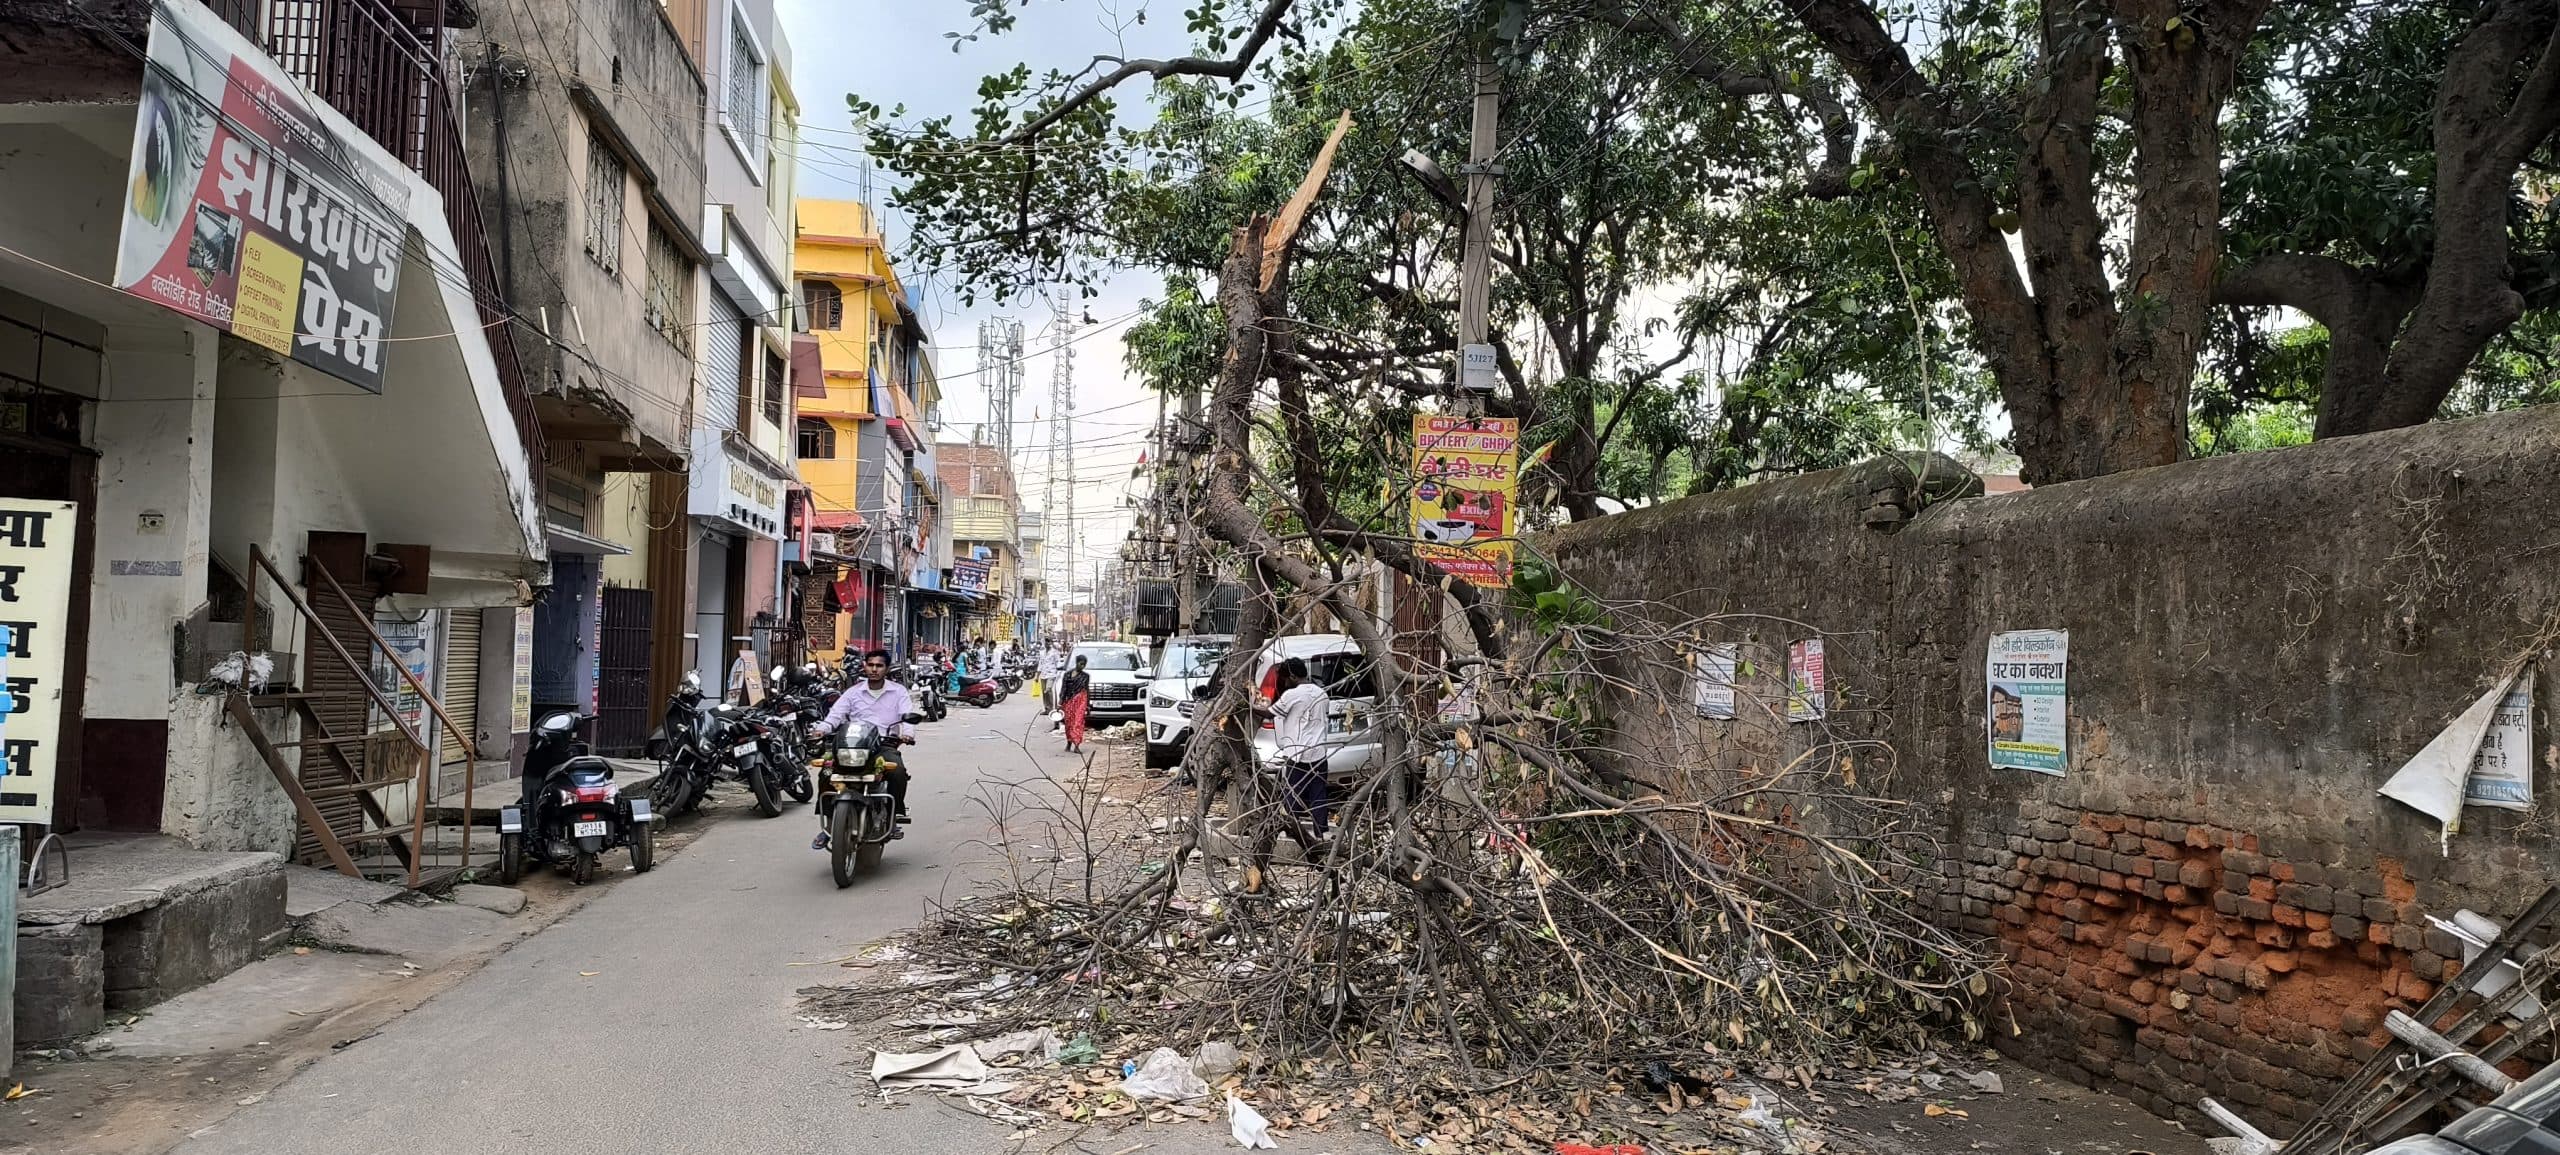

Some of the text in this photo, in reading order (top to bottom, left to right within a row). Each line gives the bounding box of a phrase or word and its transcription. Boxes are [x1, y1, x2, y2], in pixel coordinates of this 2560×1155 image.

[217, 135, 404, 294] झारखण्ड
[248, 247, 261, 263] FLEX
[246, 265, 287, 294] SCREEN PRINTING
[203, 288, 234, 325] गिरिडीह
[243, 285, 283, 312] OFFSET PRINTING
[240, 304, 281, 330] DIGITAL PRINTING
[297, 260, 384, 375] प्रेस
[253, 327, 273, 347] COLOUR
[271, 334, 290, 352] POSTER
[1419, 433, 1468, 449] BATTERY
[1473, 464, 1509, 481] घर
[1459, 504, 1491, 516] EXIDE
[2011, 637, 2022, 653] हरि
[1992, 662, 2064, 679] घर का नक्शा
[2496, 732, 2503, 751] है
[2488, 754, 2498, 769] पर
[2500, 753, 2508, 769] है
